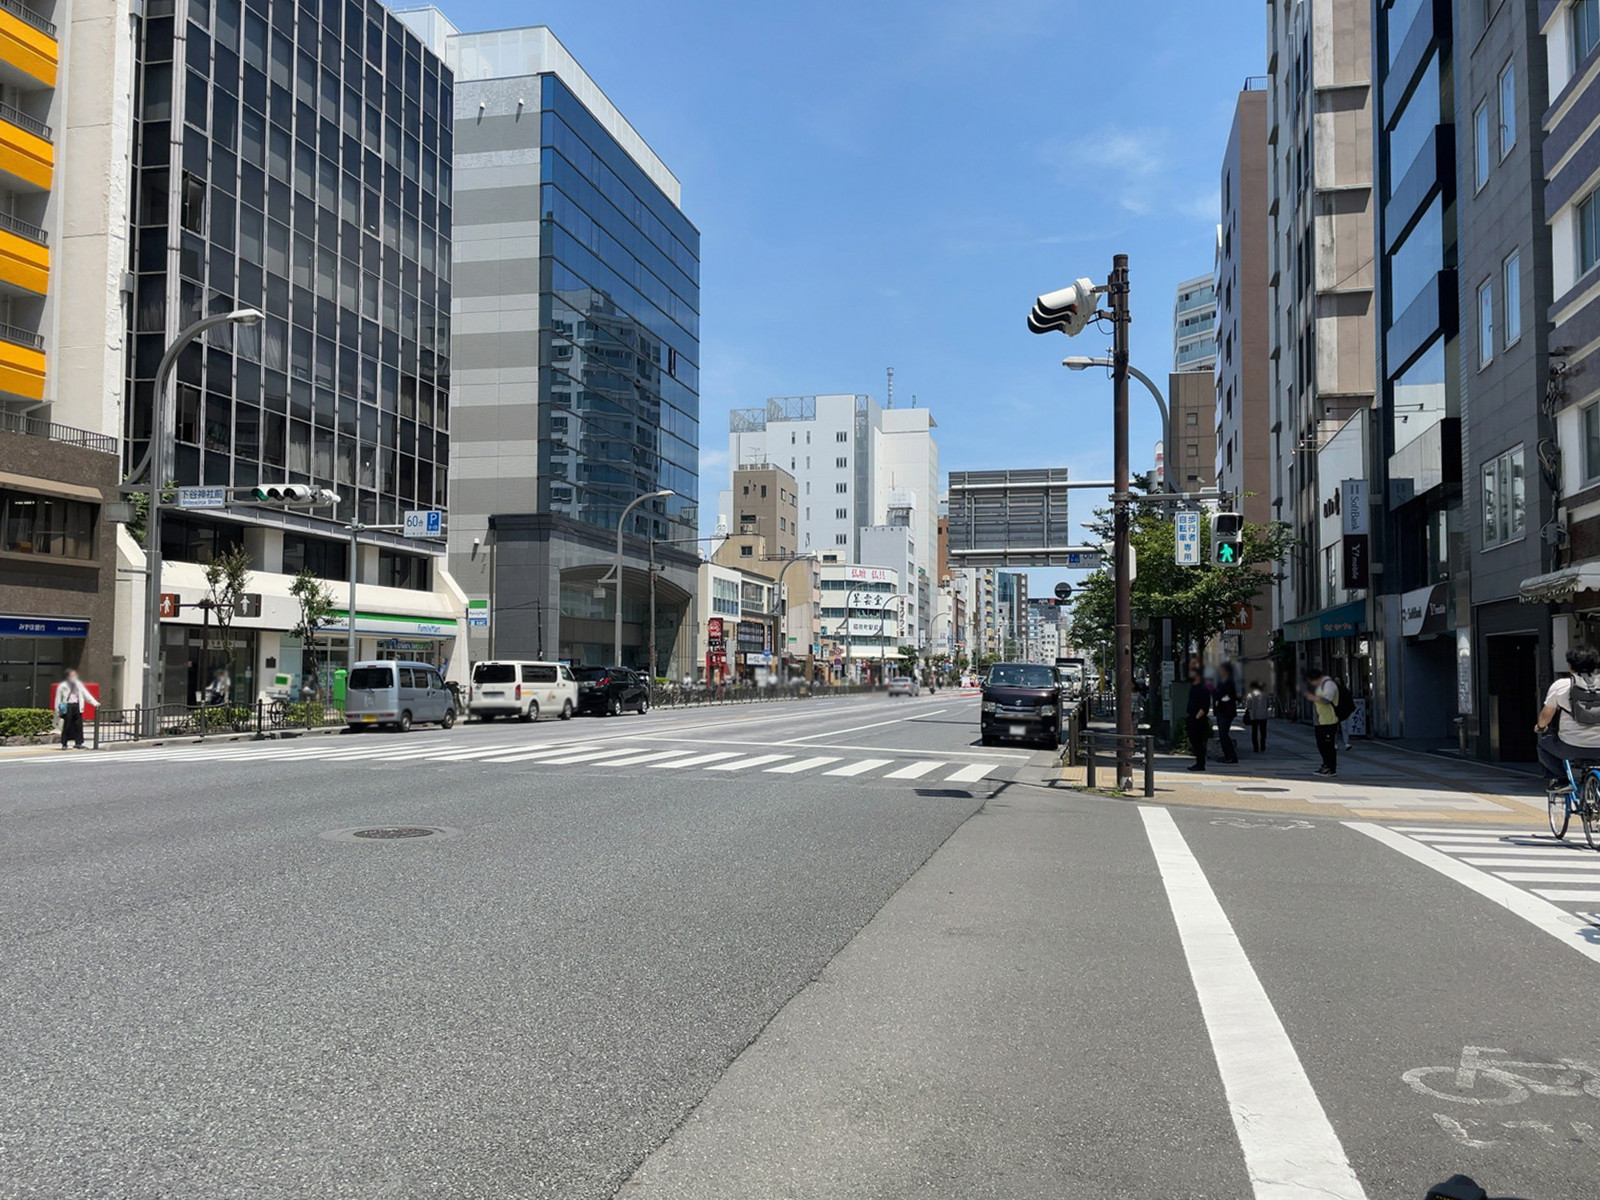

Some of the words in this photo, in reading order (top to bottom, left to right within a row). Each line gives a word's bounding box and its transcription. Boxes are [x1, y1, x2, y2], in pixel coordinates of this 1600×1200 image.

[181, 489, 222, 499] 下谷神社前
[1351, 496, 1359, 531] SoftBank
[18, 623, 46, 632] みずほ銀行
[417, 624, 441, 633] FamilyMart
